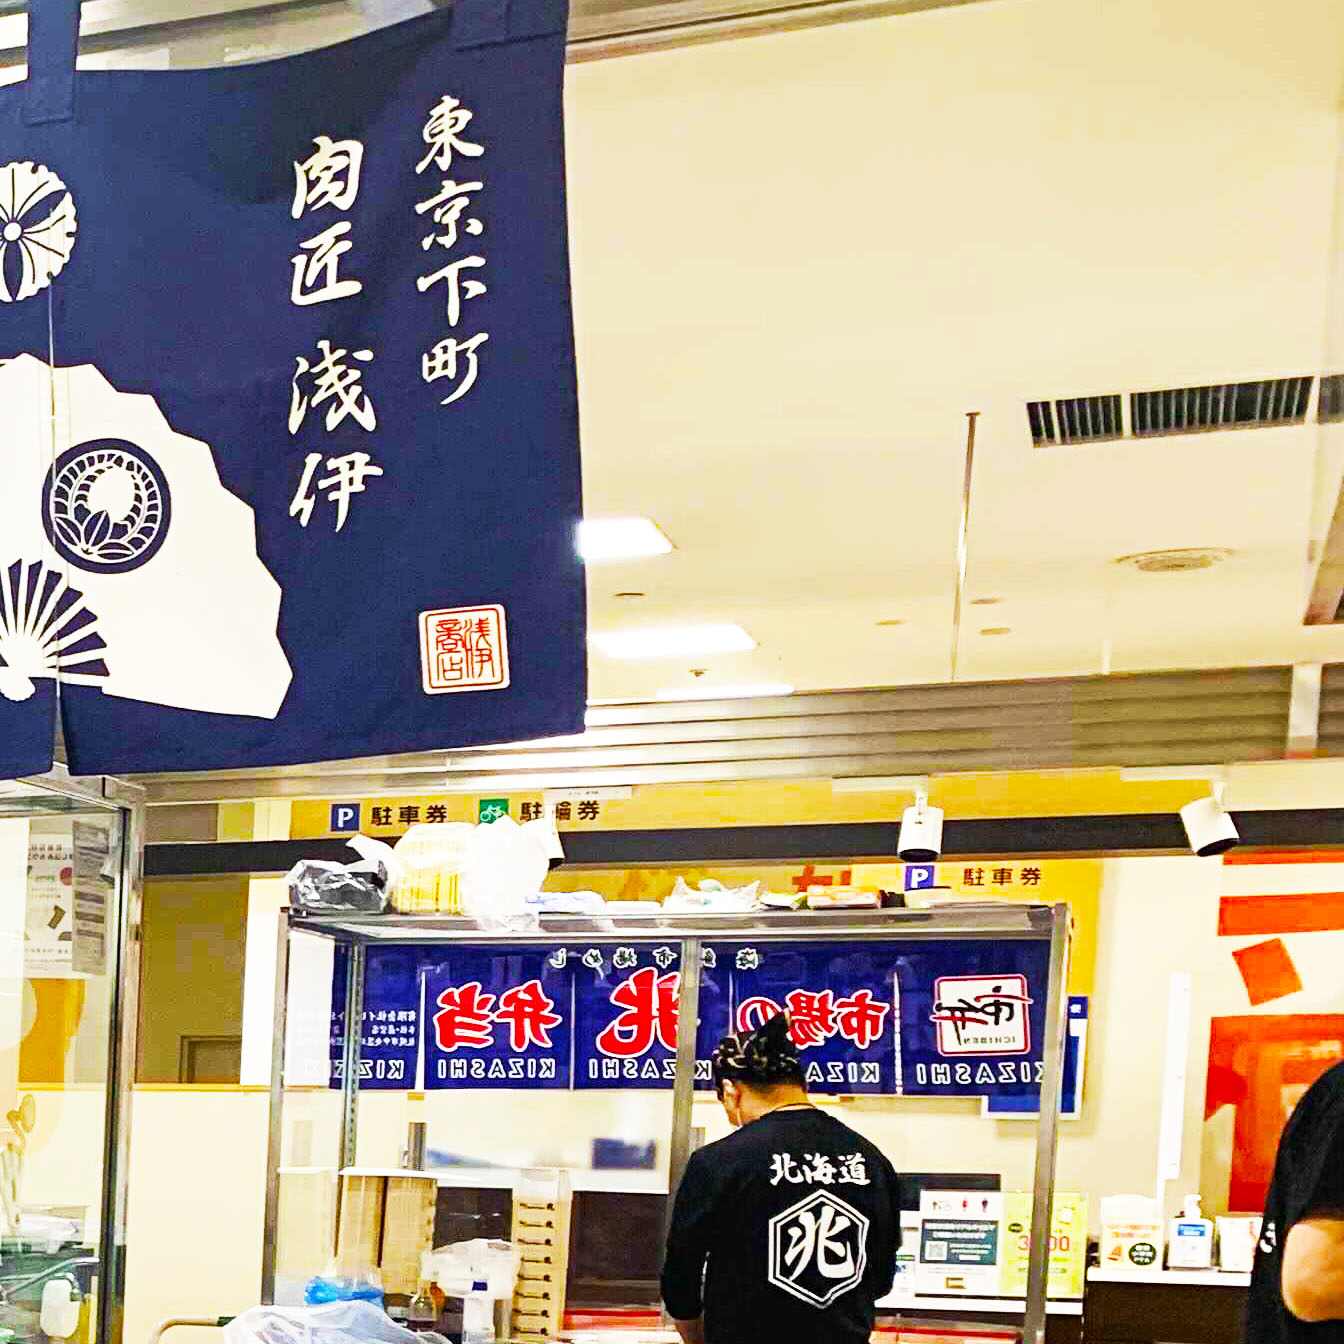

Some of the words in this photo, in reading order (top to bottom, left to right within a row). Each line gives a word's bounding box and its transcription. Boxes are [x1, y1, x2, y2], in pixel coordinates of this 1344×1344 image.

[415, 95, 490, 405] 東京下町
[371, 804, 447, 825] 駐車券
[912, 869, 928, 888] P
[963, 867, 1041, 886] 駐車券
[770, 1152, 871, 1186] 北海道
[784, 1205, 857, 1282] 兆
